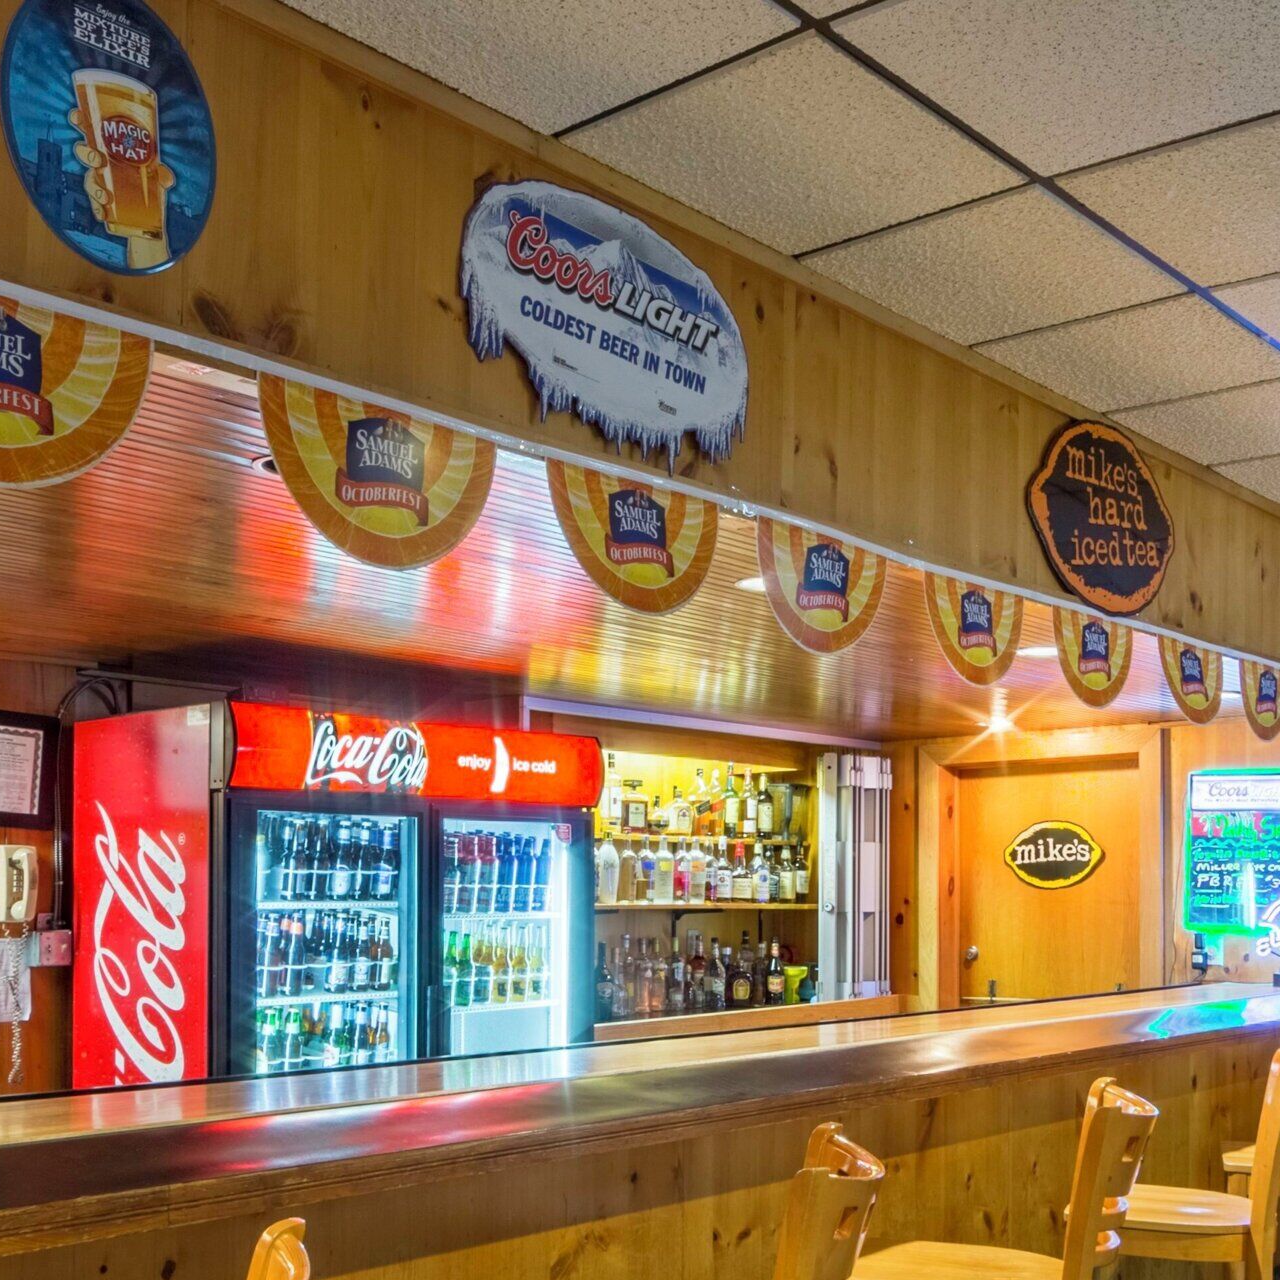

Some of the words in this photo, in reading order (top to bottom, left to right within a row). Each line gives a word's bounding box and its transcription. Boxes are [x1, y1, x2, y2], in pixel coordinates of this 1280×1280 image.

[74, 7, 150, 48] MIXTURE
[119, 14, 131, 25] the
[74, 17, 96, 32] OF
[102, 29, 150, 56] LIFE'S
[74, 26, 150, 68] ELIXIR
[103, 119, 150, 143] MAGIC
[111, 142, 148, 161] HAT
[506, 210, 615, 306] Coors
[612, 282, 721, 350] LIGHT
[519, 295, 596, 344] COLDEST
[598, 330, 639, 366] BEER
[643, 348, 661, 375] IN
[664, 358, 707, 395] TOWN
[355, 429, 418, 465] SAMUEL
[358, 452, 413, 479] ADAMS
[1065, 445, 1138, 497] mike's
[341, 484, 421, 511] OCTOBERFEST
[1087, 487, 1148, 530] hard
[614, 499, 661, 527] SAMUEL
[620, 518, 658, 539] ADAMS
[610, 547, 668, 564] OCTOBERFEST
[1071, 528, 1123, 567] iced
[1122, 530, 1160, 567] tea
[809, 552, 846, 577] SAMUEL
[811, 567, 842, 588] ADAMS
[799, 594, 846, 610] OCTOBERFEST
[964, 599, 990, 618] SAMUEL
[305, 719, 428, 786] Coca-Cola
[457, 754, 492, 770] enjoy
[512, 757, 531, 773] ice
[531, 759, 556, 774] cold
[1208, 782, 1249, 797] Coors
[1014, 837, 1092, 865] mike's
